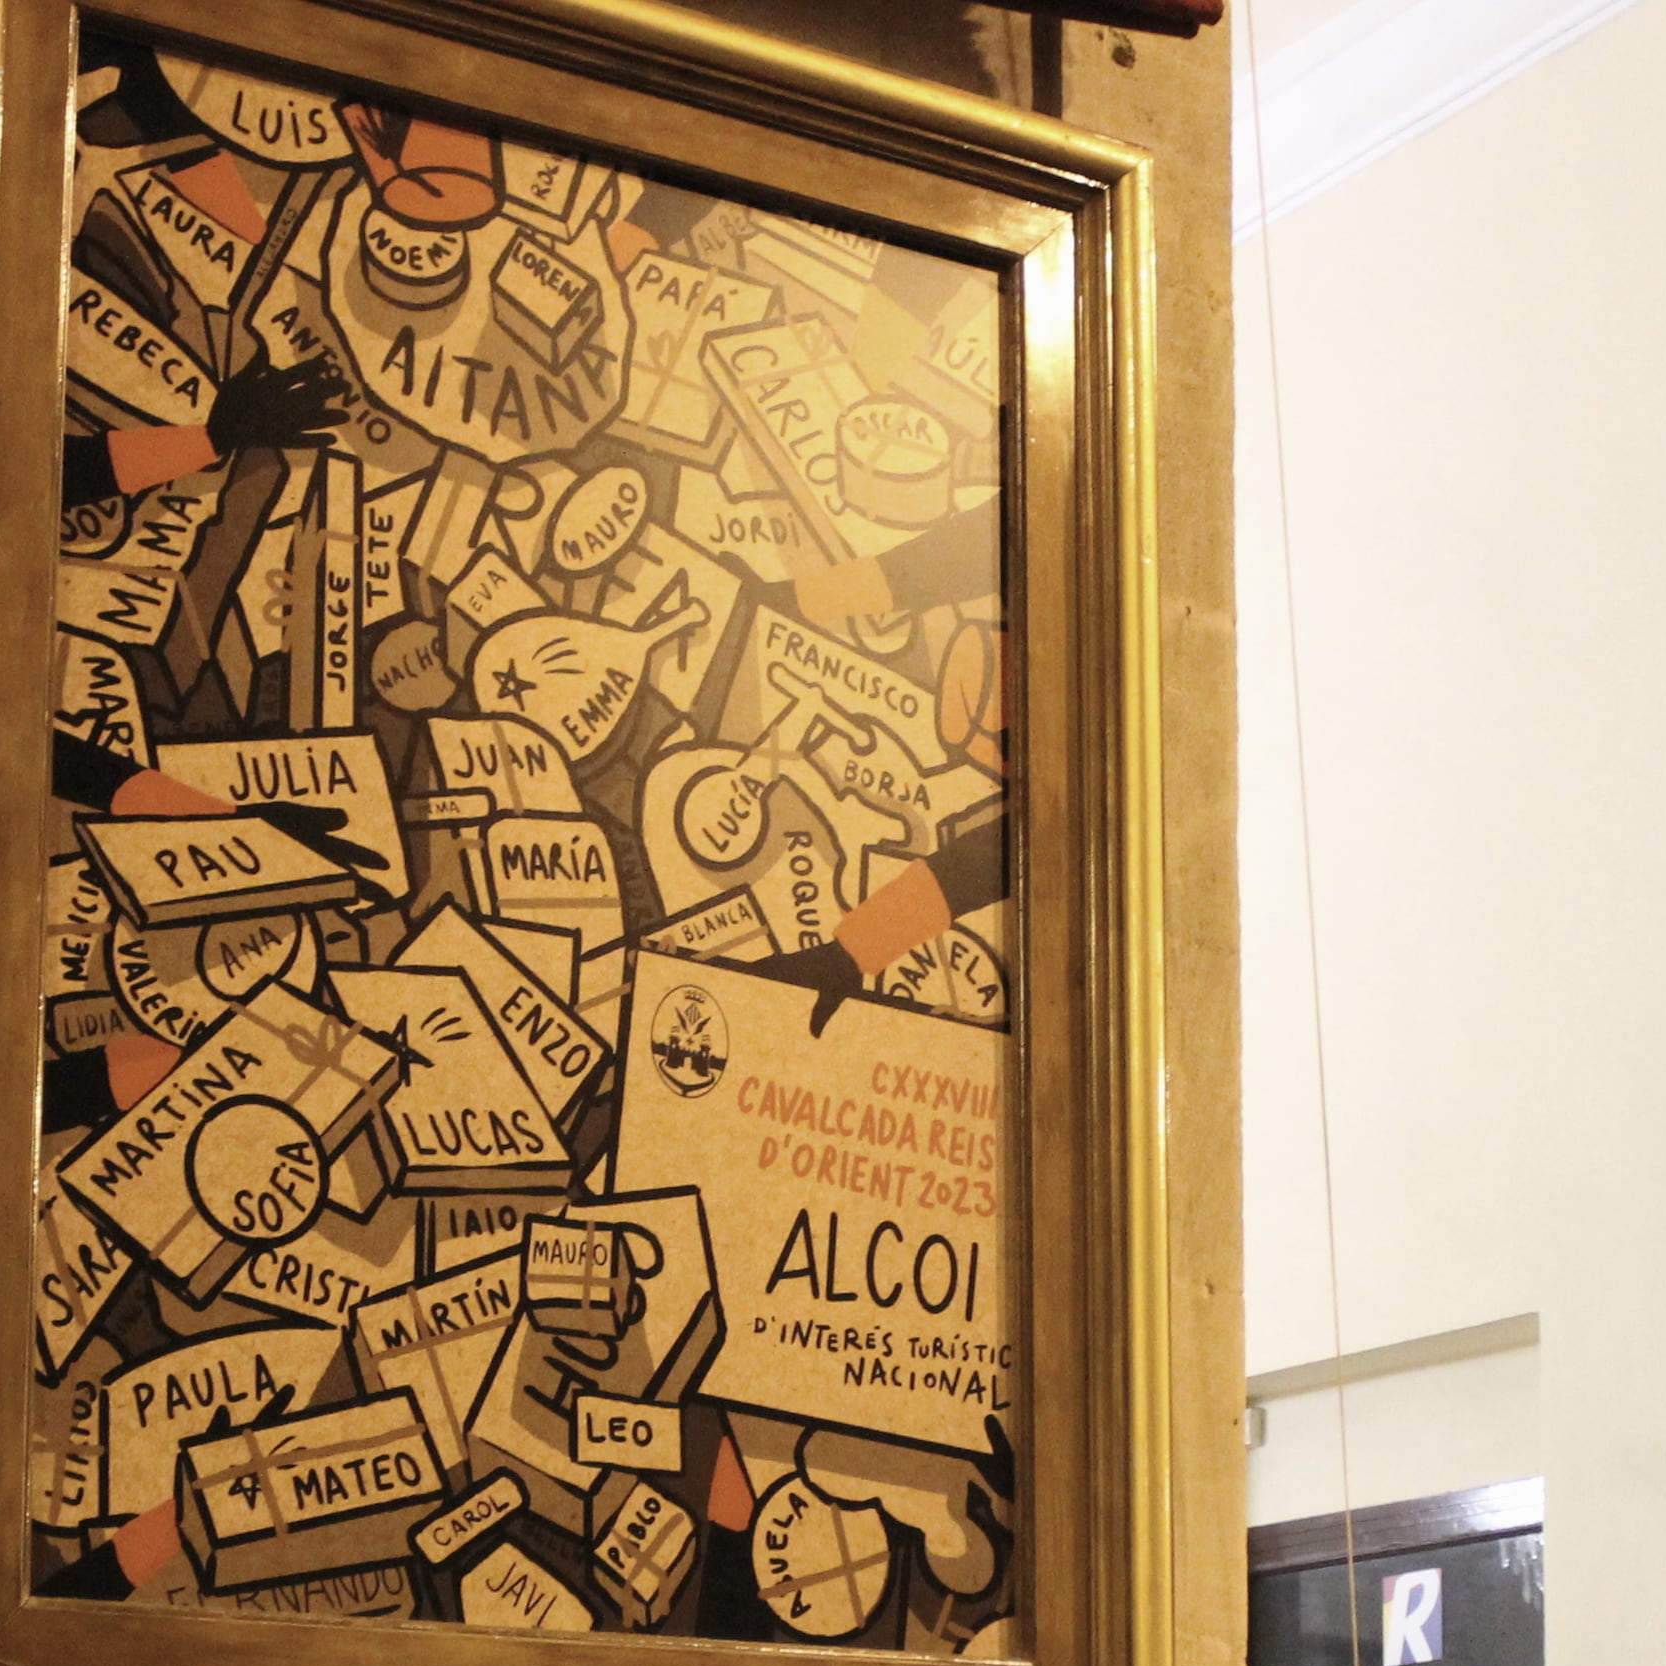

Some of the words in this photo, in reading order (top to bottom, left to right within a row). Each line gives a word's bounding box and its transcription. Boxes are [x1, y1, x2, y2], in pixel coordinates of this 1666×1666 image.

[132, 179, 236, 273] LAURA
[68, 290, 204, 408] REBECA
[381, 326, 618, 440] AITANA
[730, 344, 847, 518] CARLOS
[367, 507, 394, 609] TETE
[561, 482, 638, 564] MAURO
[469, 570, 509, 614] EVA
[327, 570, 351, 693] JORGE
[766, 621, 920, 720] FRANCISCO
[561, 667, 635, 748] EMMA
[844, 759, 932, 811] BORJA
[155, 836, 262, 888] PAU
[501, 835, 607, 883] MARÍA
[783, 830, 822, 951] ROQUE
[219, 926, 283, 979] ANA
[682, 904, 753, 944] BLANCA
[889, 940, 1000, 1009] DANELA
[63, 1008, 126, 1045] LIDIA
[499, 986, 592, 1079] ENZO
[403, 1109, 544, 1158] LUCAS
[738, 1076, 918, 1154] CAVALCADA
[931, 1119, 995, 1173] REIS
[758, 1133, 915, 1209] D'ORIENT
[918, 1176, 997, 1218] 2023
[450, 1204, 518, 1238] IAIO
[765, 1208, 979, 1322] ALCOI
[134, 1353, 277, 1428] PAULA
[844, 1358, 1012, 1412] NACIONAL
[585, 1412, 654, 1448] LEO
[291, 1451, 422, 1511] MATEO
[433, 1492, 511, 1546] CAROL
[486, 1561, 559, 1628] JAVI
